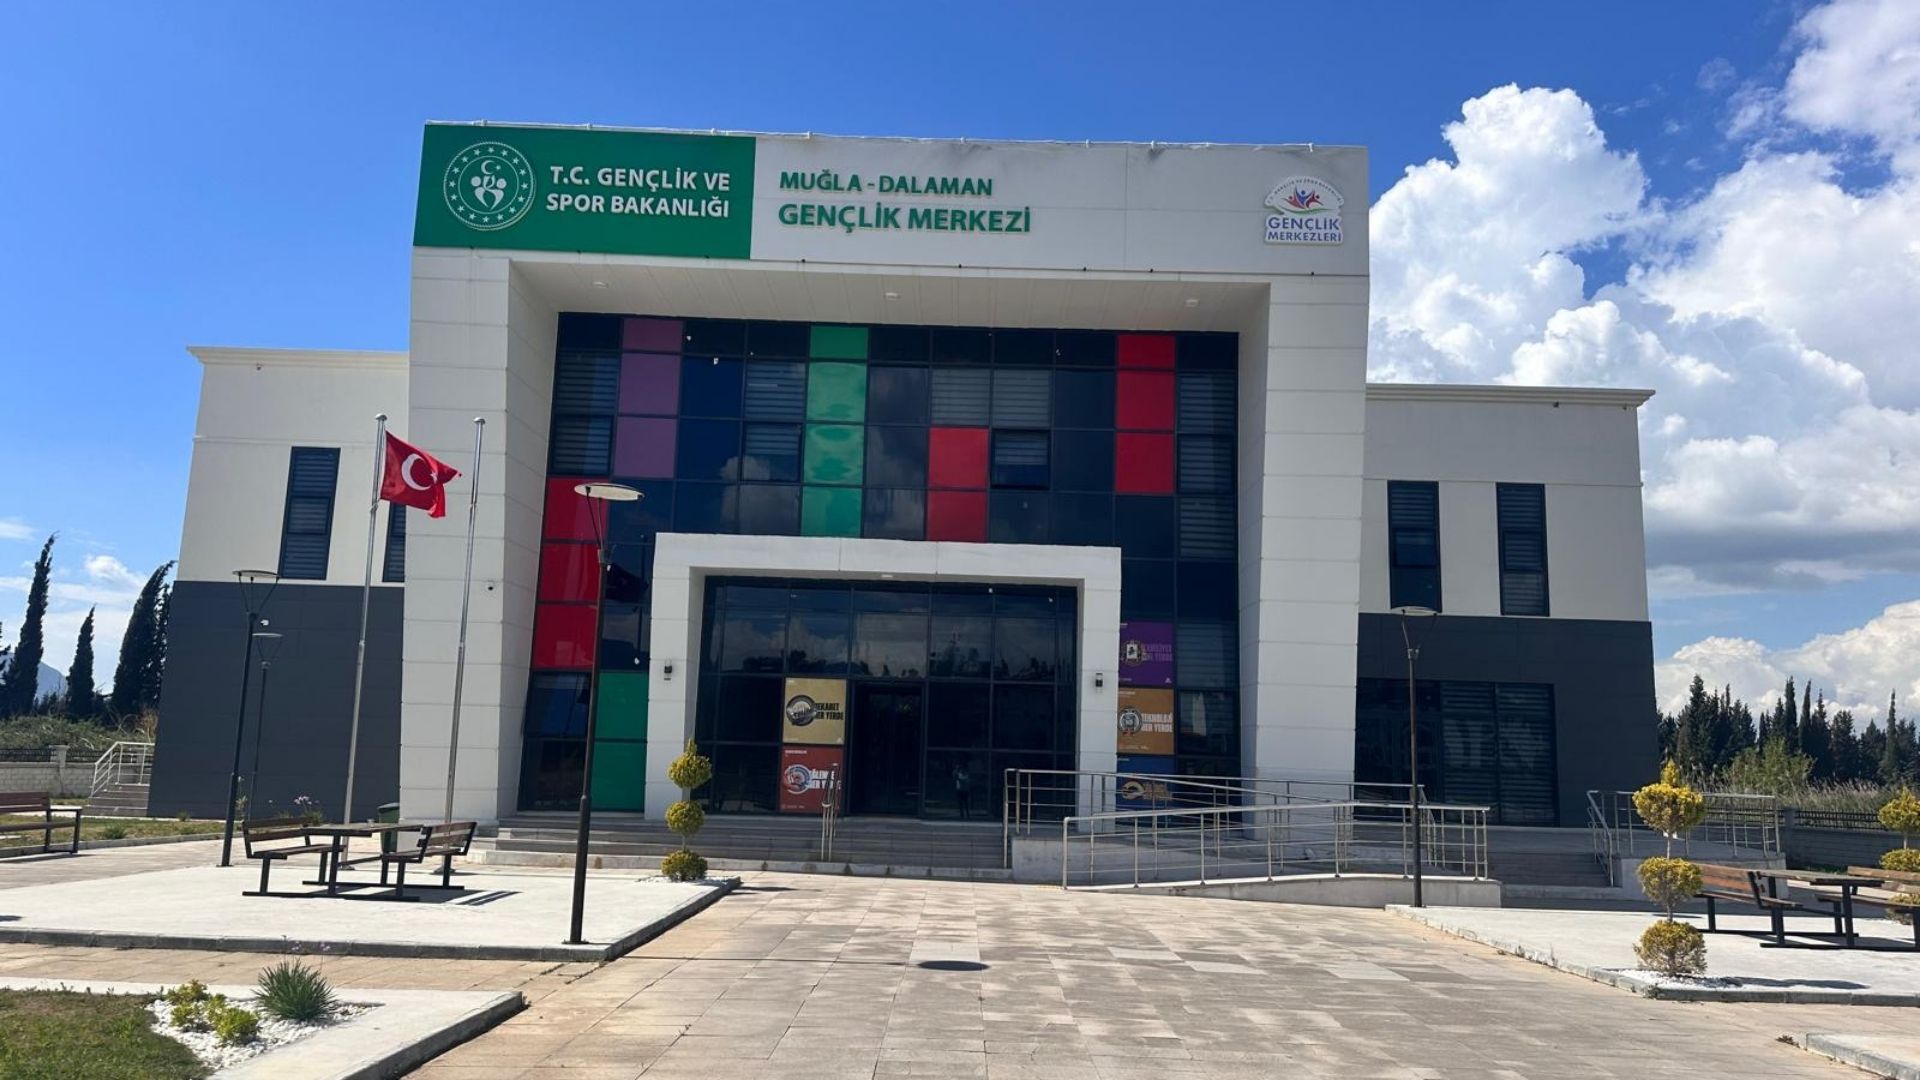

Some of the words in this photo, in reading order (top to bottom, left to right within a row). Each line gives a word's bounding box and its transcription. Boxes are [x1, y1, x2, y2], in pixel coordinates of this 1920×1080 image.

[550, 165, 590, 185] T.C.
[597, 167, 698, 193] GENÇLİK
[704, 172, 731, 191] VE
[779, 169, 863, 192] MUĞLA
[879, 175, 993, 196] DALAMAN
[546, 193, 605, 213] SPOR
[610, 195, 729, 218] BAKANLIĞI
[778, 201, 902, 234] GENÇLİK
[907, 206, 1031, 233] MERKEZİ
